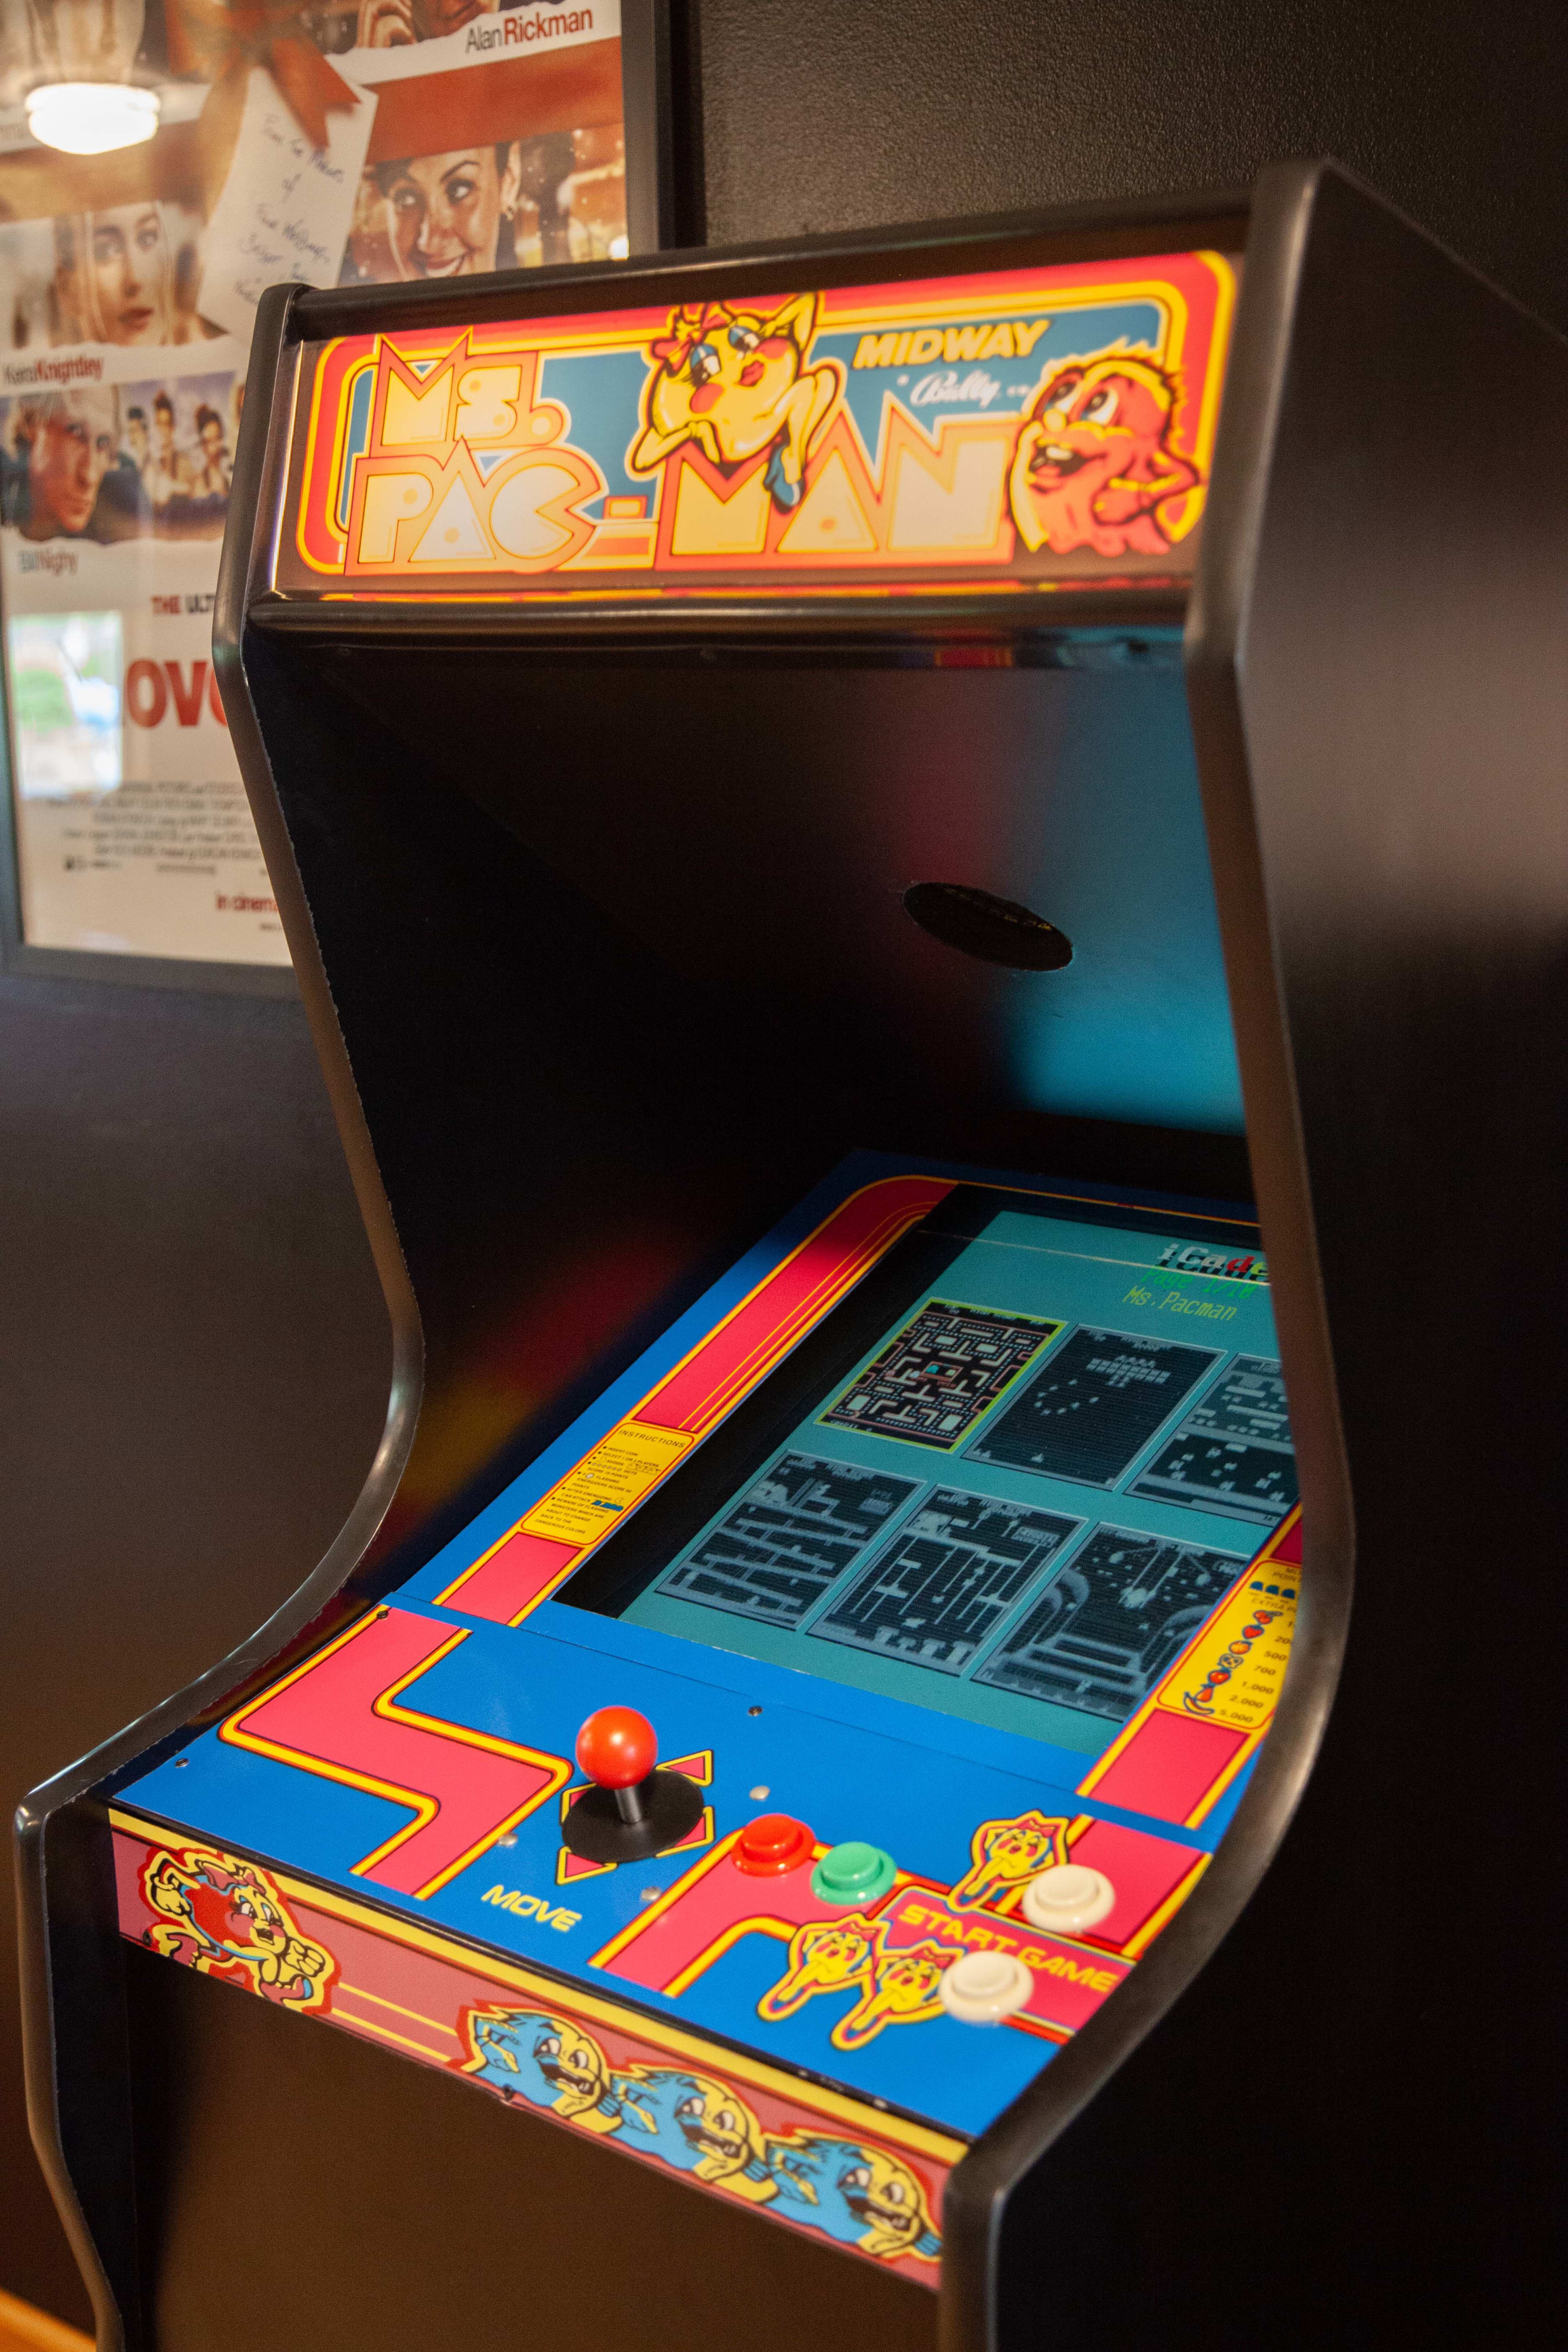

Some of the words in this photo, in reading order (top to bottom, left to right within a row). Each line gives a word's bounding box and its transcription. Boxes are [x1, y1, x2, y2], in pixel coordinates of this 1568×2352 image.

[852, 319, 1051, 370] MIDWAY
[909, 370, 1001, 409] Bally
[152, 595, 181, 615] THE
[1157, 1243, 1269, 1277] iCade
[1140, 1265, 1194, 1289] Page
[1203, 1276, 1259, 1299] 1/10
[618, 1429, 685, 1448] INSTRUCTIONS
[577, 1478, 607, 1487] ENERGIZERS
[583, 1492, 612, 1501] ENERGIZING
[551, 1503, 578, 1512] MONSTERS
[584, 1505, 609, 1513] FLASHING
[535, 1519, 565, 1529] DANGEROUS
[1275, 1636, 1292, 1645] 20
[1264, 1650, 1288, 1661] 500
[1254, 1665, 1276, 1676] 700
[481, 1884, 582, 1932] MOVE
[898, 1904, 1018, 1954] START
[1017, 1946, 1121, 1993] GAME
